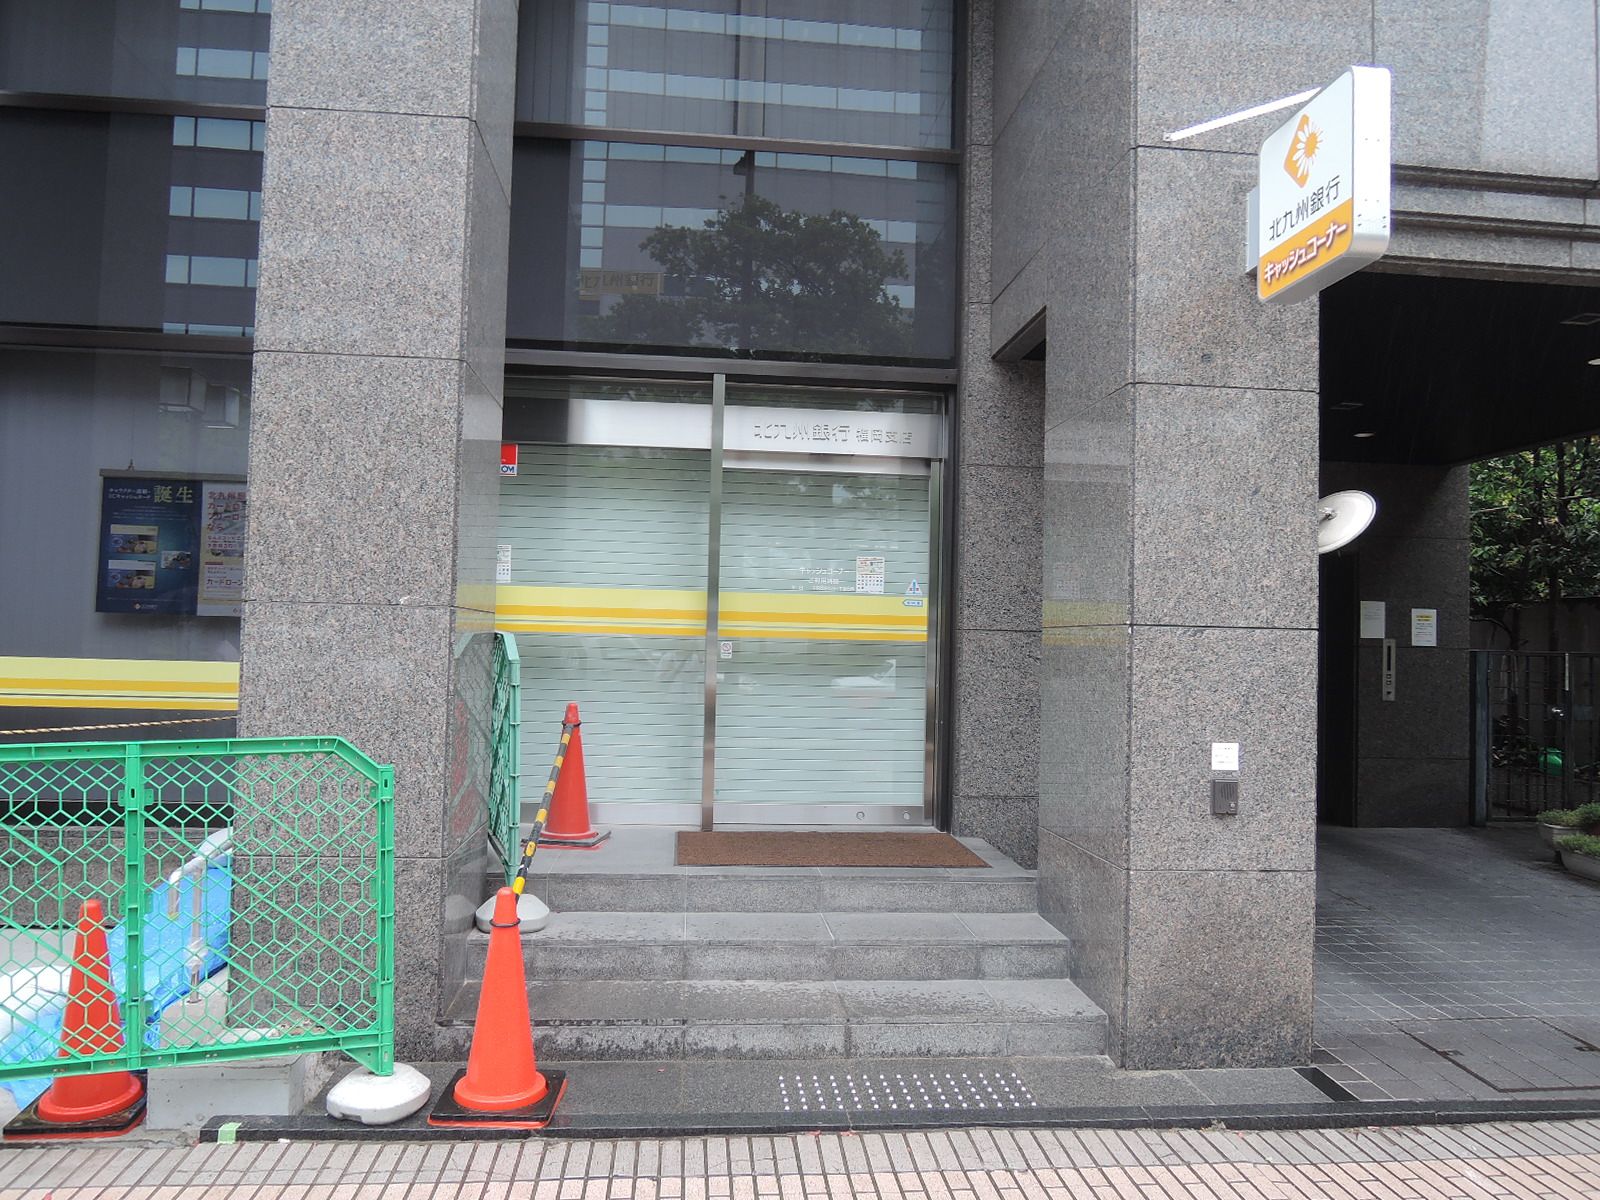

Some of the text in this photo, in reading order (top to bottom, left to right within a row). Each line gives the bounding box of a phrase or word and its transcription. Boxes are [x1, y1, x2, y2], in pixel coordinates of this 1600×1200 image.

[1269, 174, 1341, 241] 北九州銀行
[1263, 221, 1348, 283] キャッシュコーナー
[753, 423, 851, 442] 北九州銀行
[153, 484, 194, 503] 誕生
